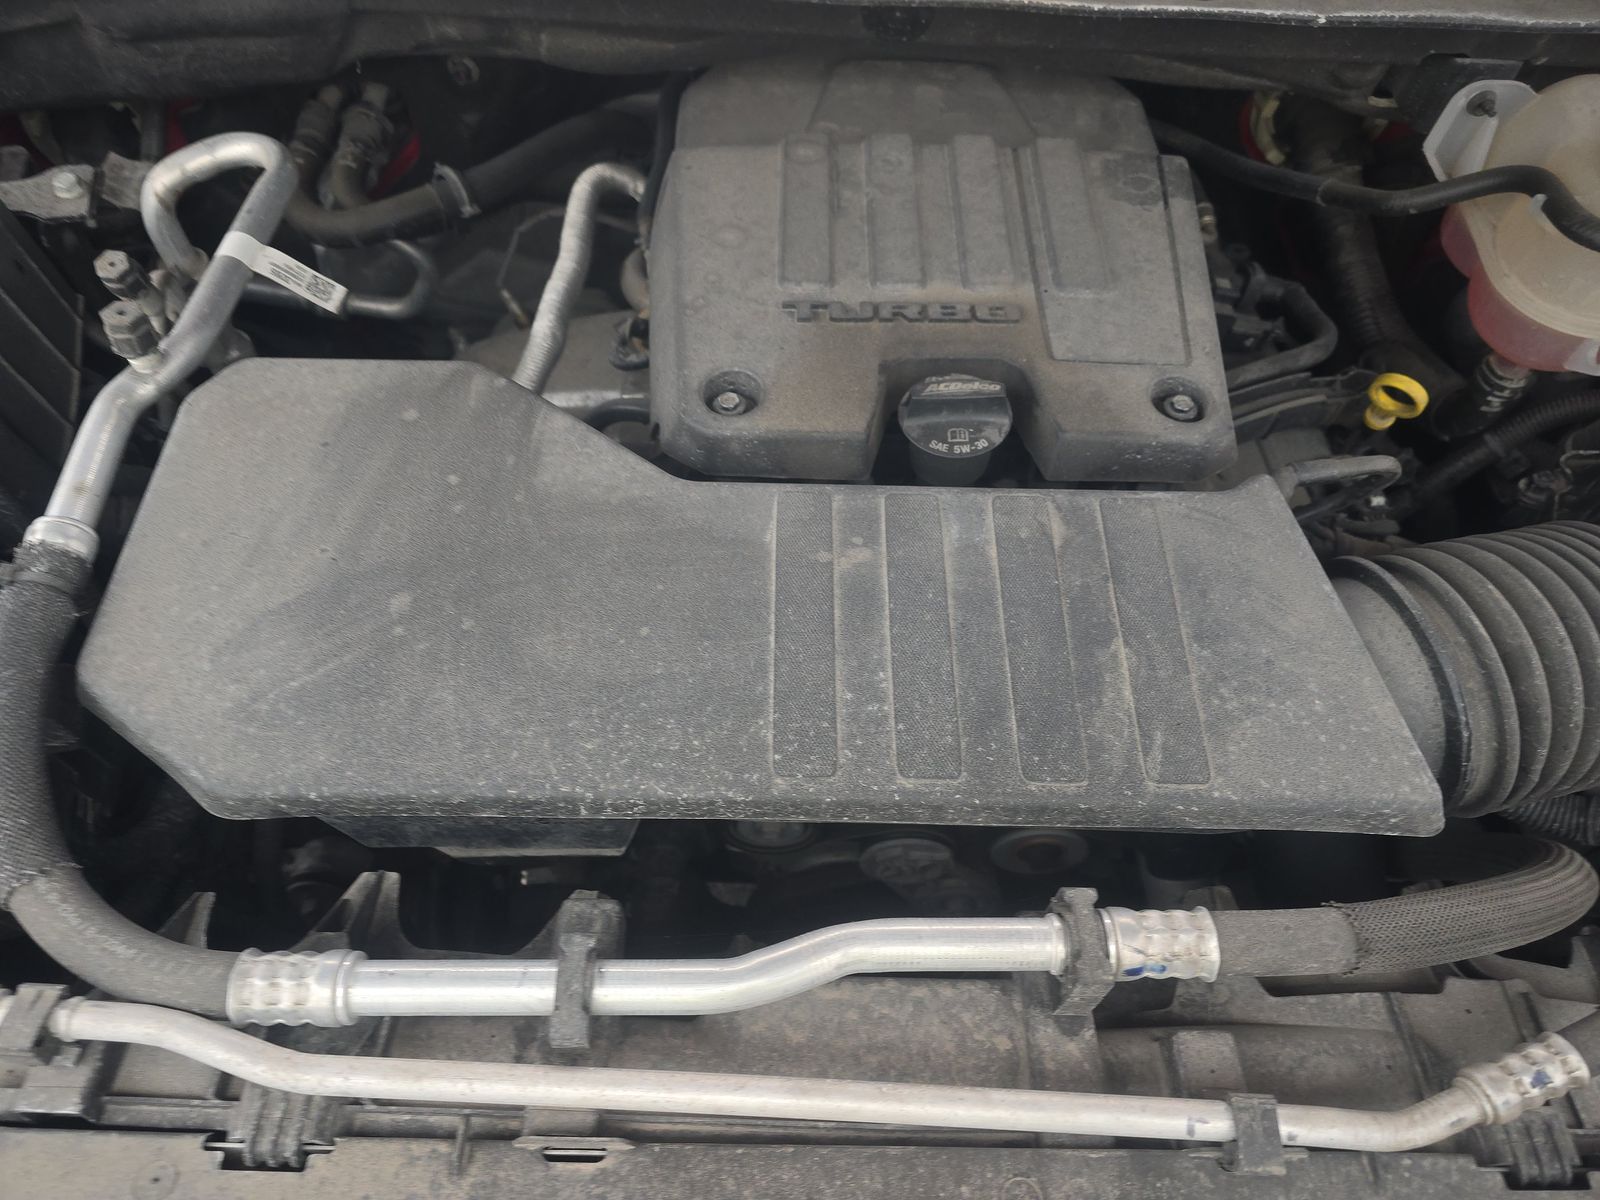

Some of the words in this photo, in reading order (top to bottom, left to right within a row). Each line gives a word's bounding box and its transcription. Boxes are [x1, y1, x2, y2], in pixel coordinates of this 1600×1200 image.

[781, 301, 1023, 323] TURBO
[923, 382, 1001, 394] ACDelco
[929, 440, 949, 453] SAE
[953, 438, 989, 454] 5W-30
